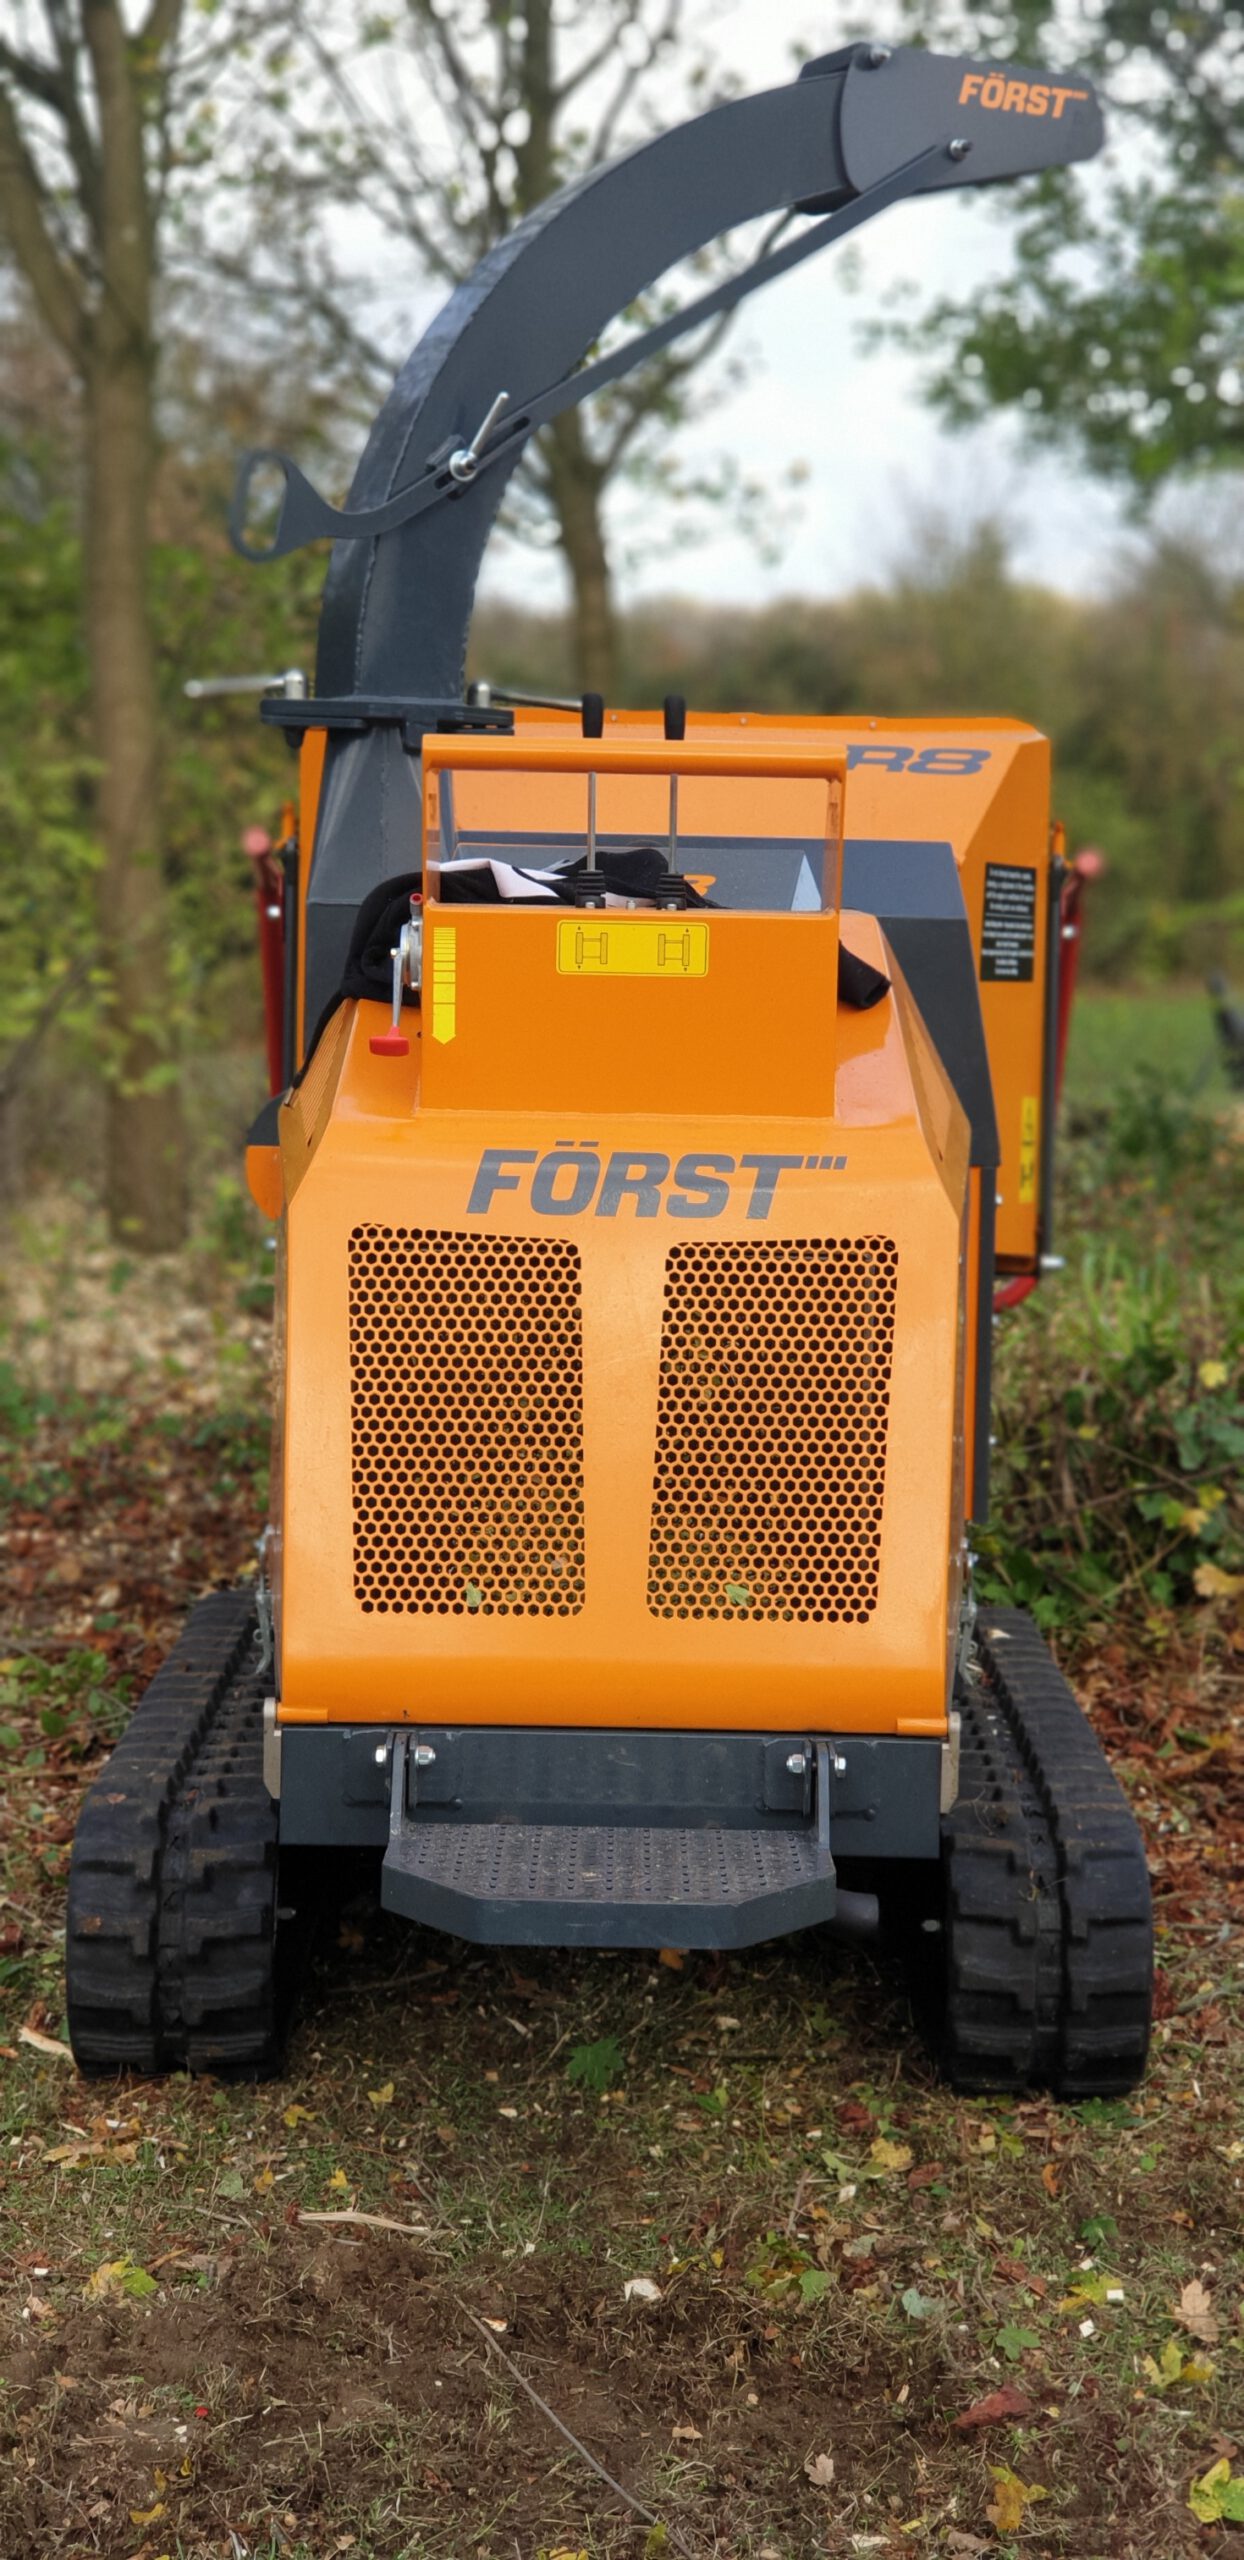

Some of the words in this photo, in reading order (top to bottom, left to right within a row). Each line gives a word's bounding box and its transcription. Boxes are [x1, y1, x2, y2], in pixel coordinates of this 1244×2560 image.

[958, 72, 1073, 119] FÖRST
[846, 744, 992, 775] R8
[466, 1140, 805, 1220] FÖRST
